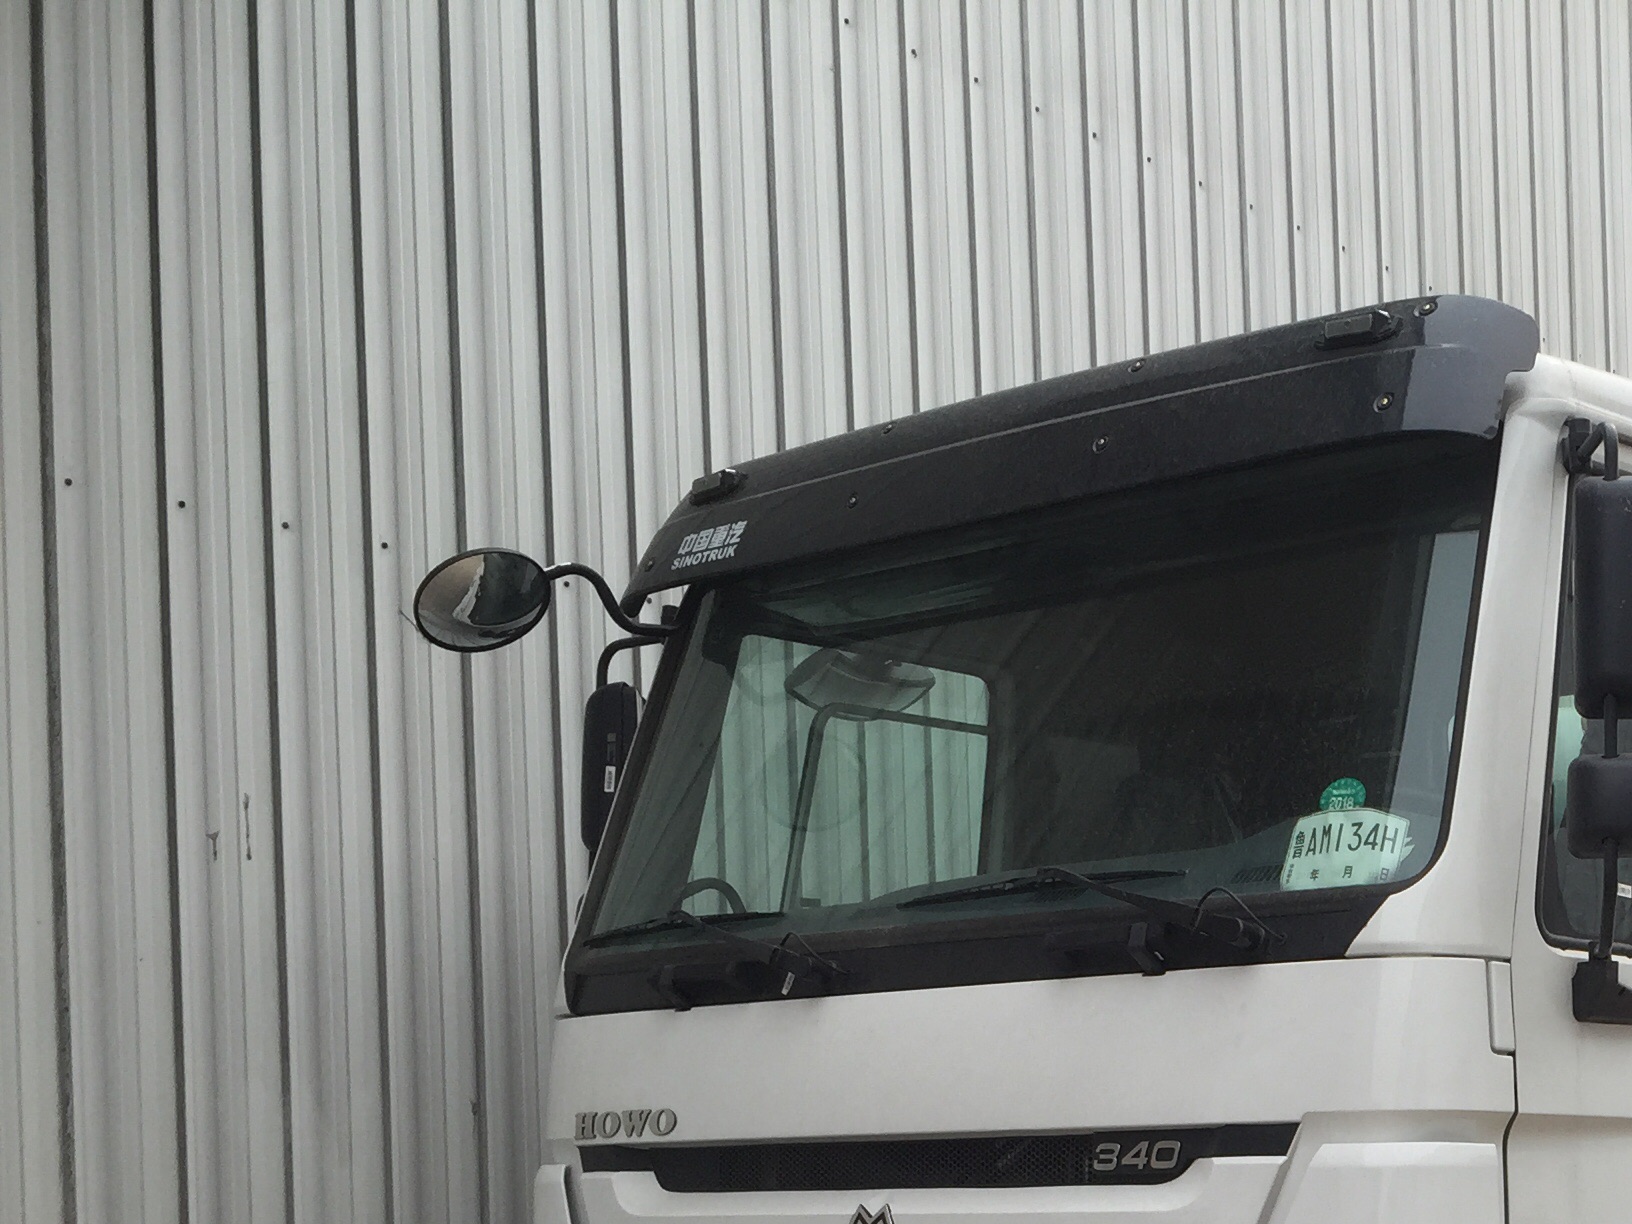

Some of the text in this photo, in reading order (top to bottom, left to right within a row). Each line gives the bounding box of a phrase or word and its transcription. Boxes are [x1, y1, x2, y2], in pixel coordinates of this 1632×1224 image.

[677, 520, 748, 555] 中国重汽
[670, 543, 738, 571] SINOTRUK
[1341, 865, 1353, 878] 月
[1379, 867, 1390, 881] 日
[574, 1108, 678, 1140] HOWO
[1093, 1140, 1181, 1171] 340
